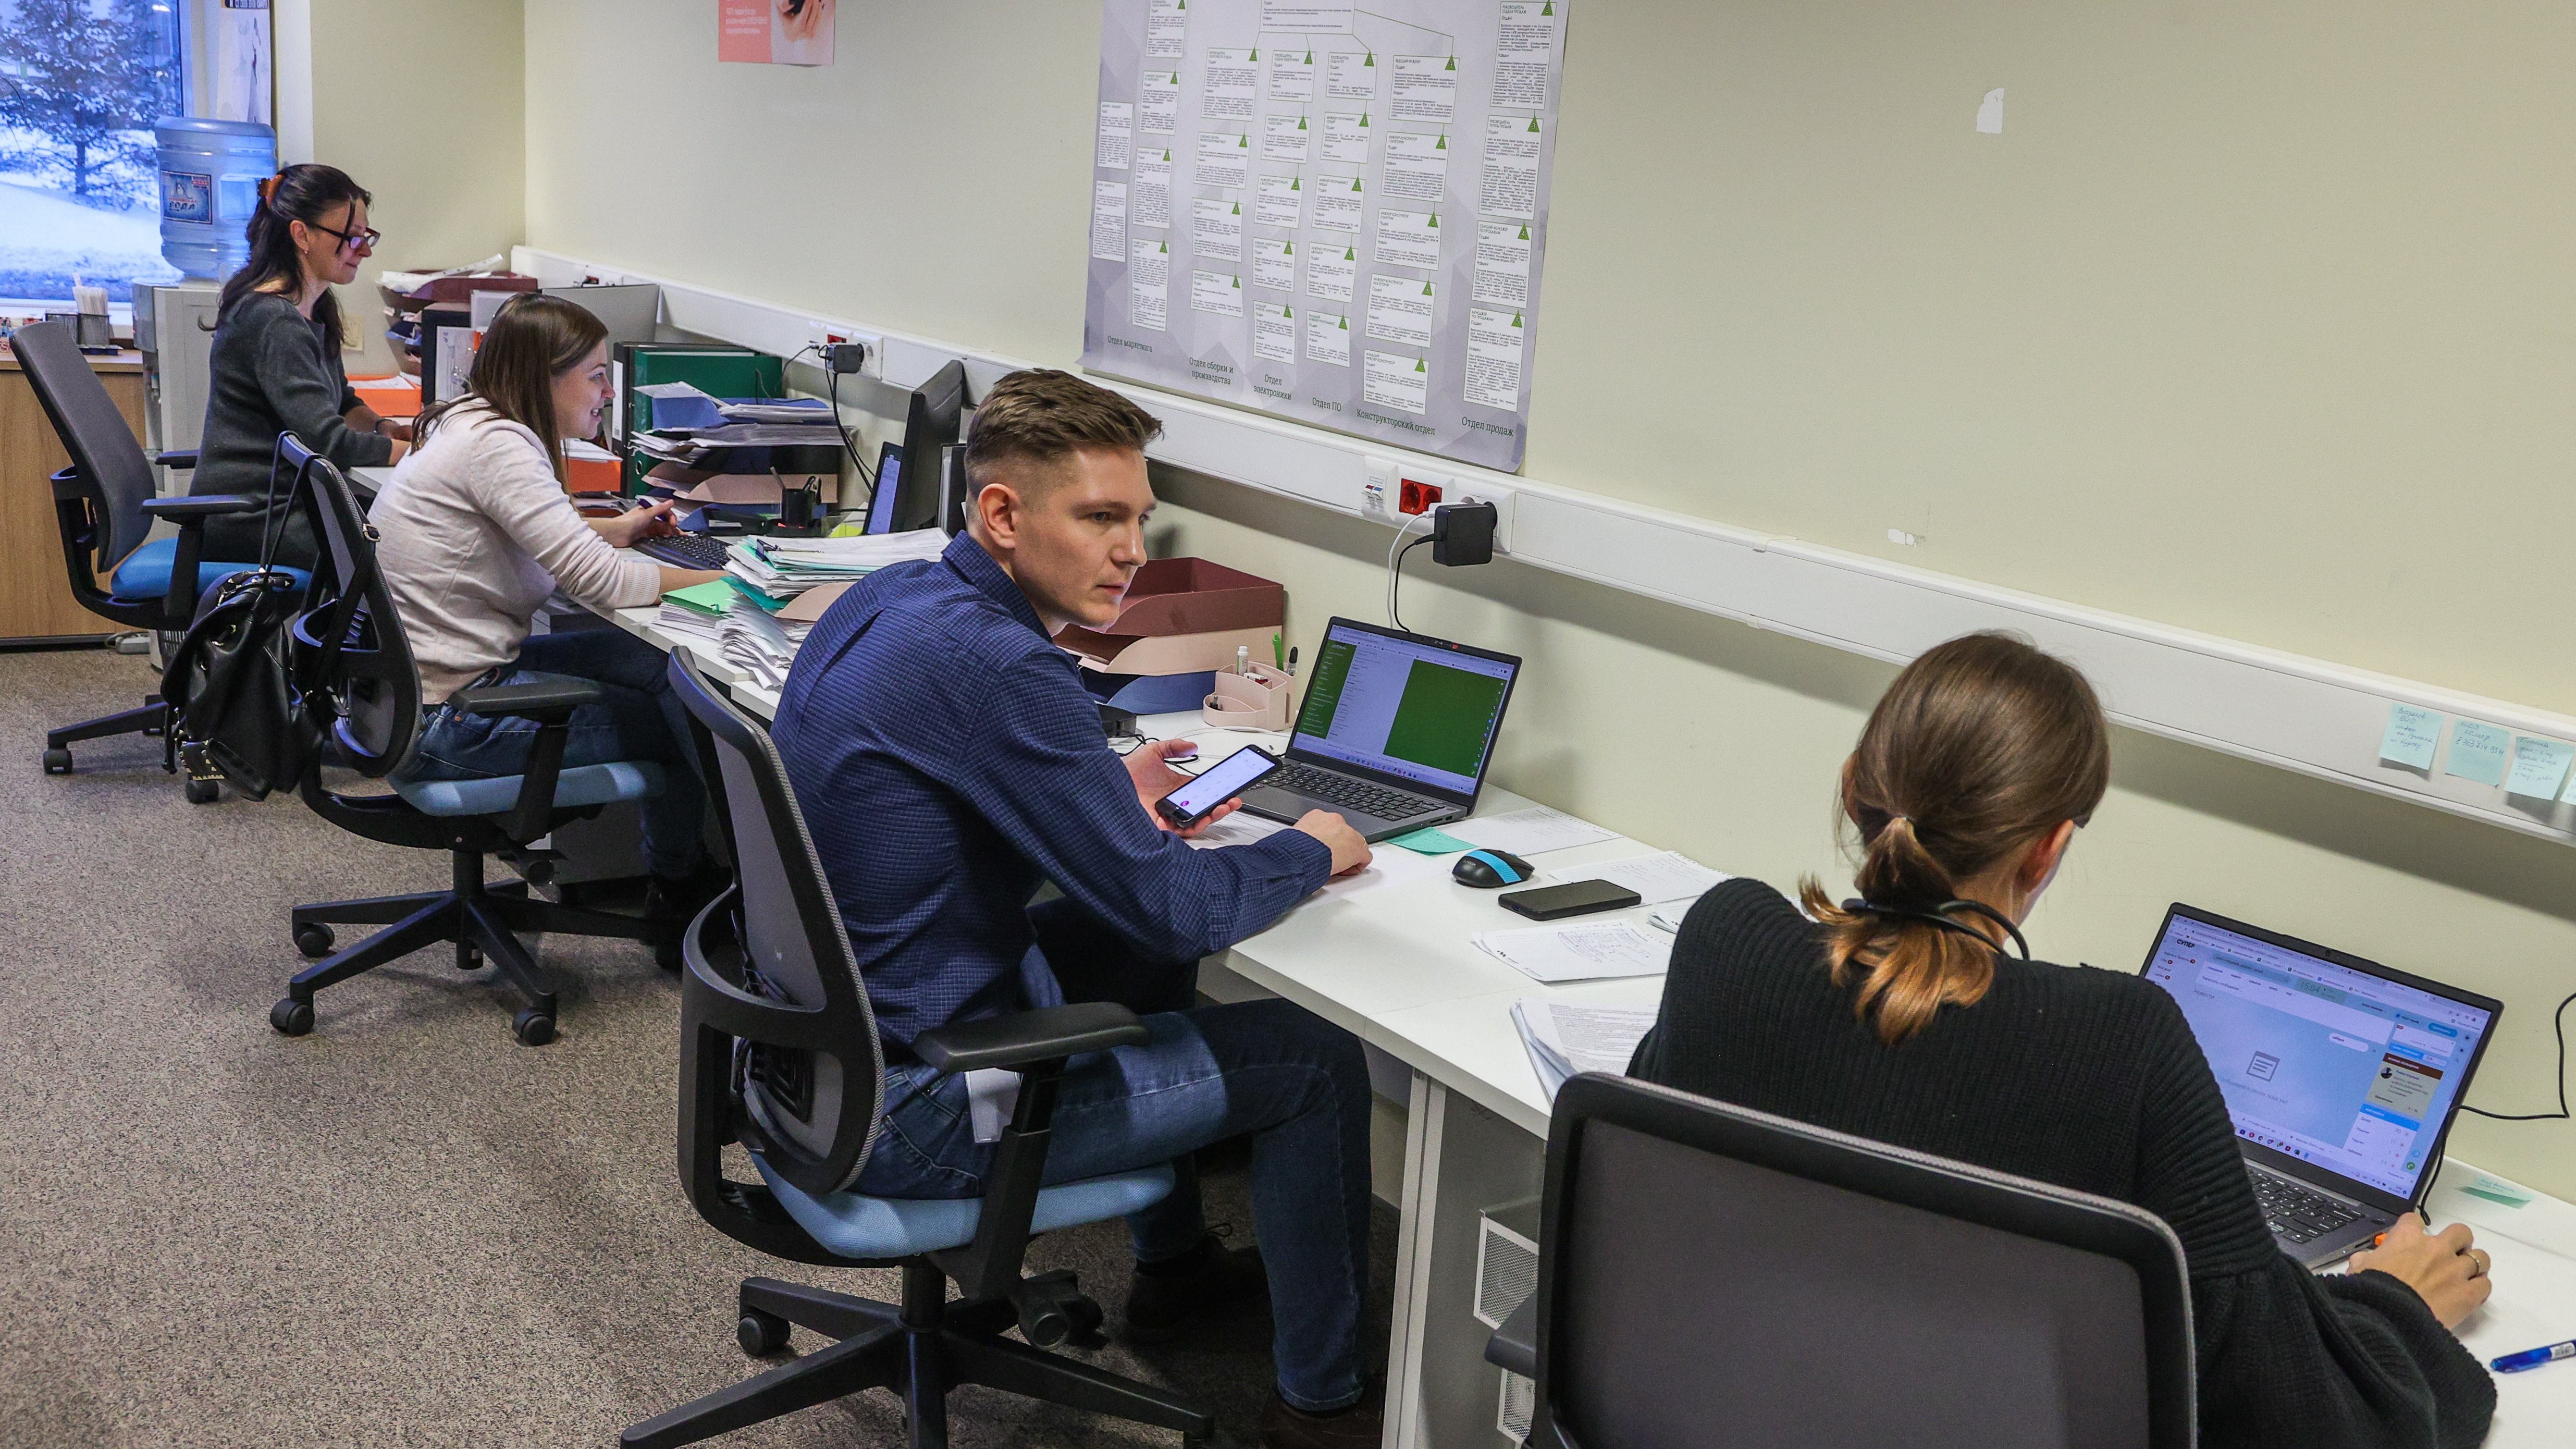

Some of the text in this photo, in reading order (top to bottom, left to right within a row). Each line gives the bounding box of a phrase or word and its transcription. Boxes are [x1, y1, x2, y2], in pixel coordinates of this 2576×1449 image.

[1108, 335, 1152, 352] Отдел маркетинга
[1189, 357, 1206, 368] Отдел
[1207, 361, 1227, 373] сборки
[1192, 371, 1231, 385] производства
[1264, 374, 1282, 386] Отдел
[1254, 385, 1291, 400] электроники
[1312, 397, 1341, 412] Отдел ПО
[1357, 409, 1435, 436] Конструкторский отдел
[1462, 416, 1514, 437] Отдел продаж
[2177, 939, 2195, 948] СУПЕР
[2194, 989, 2214, 999] Новости
